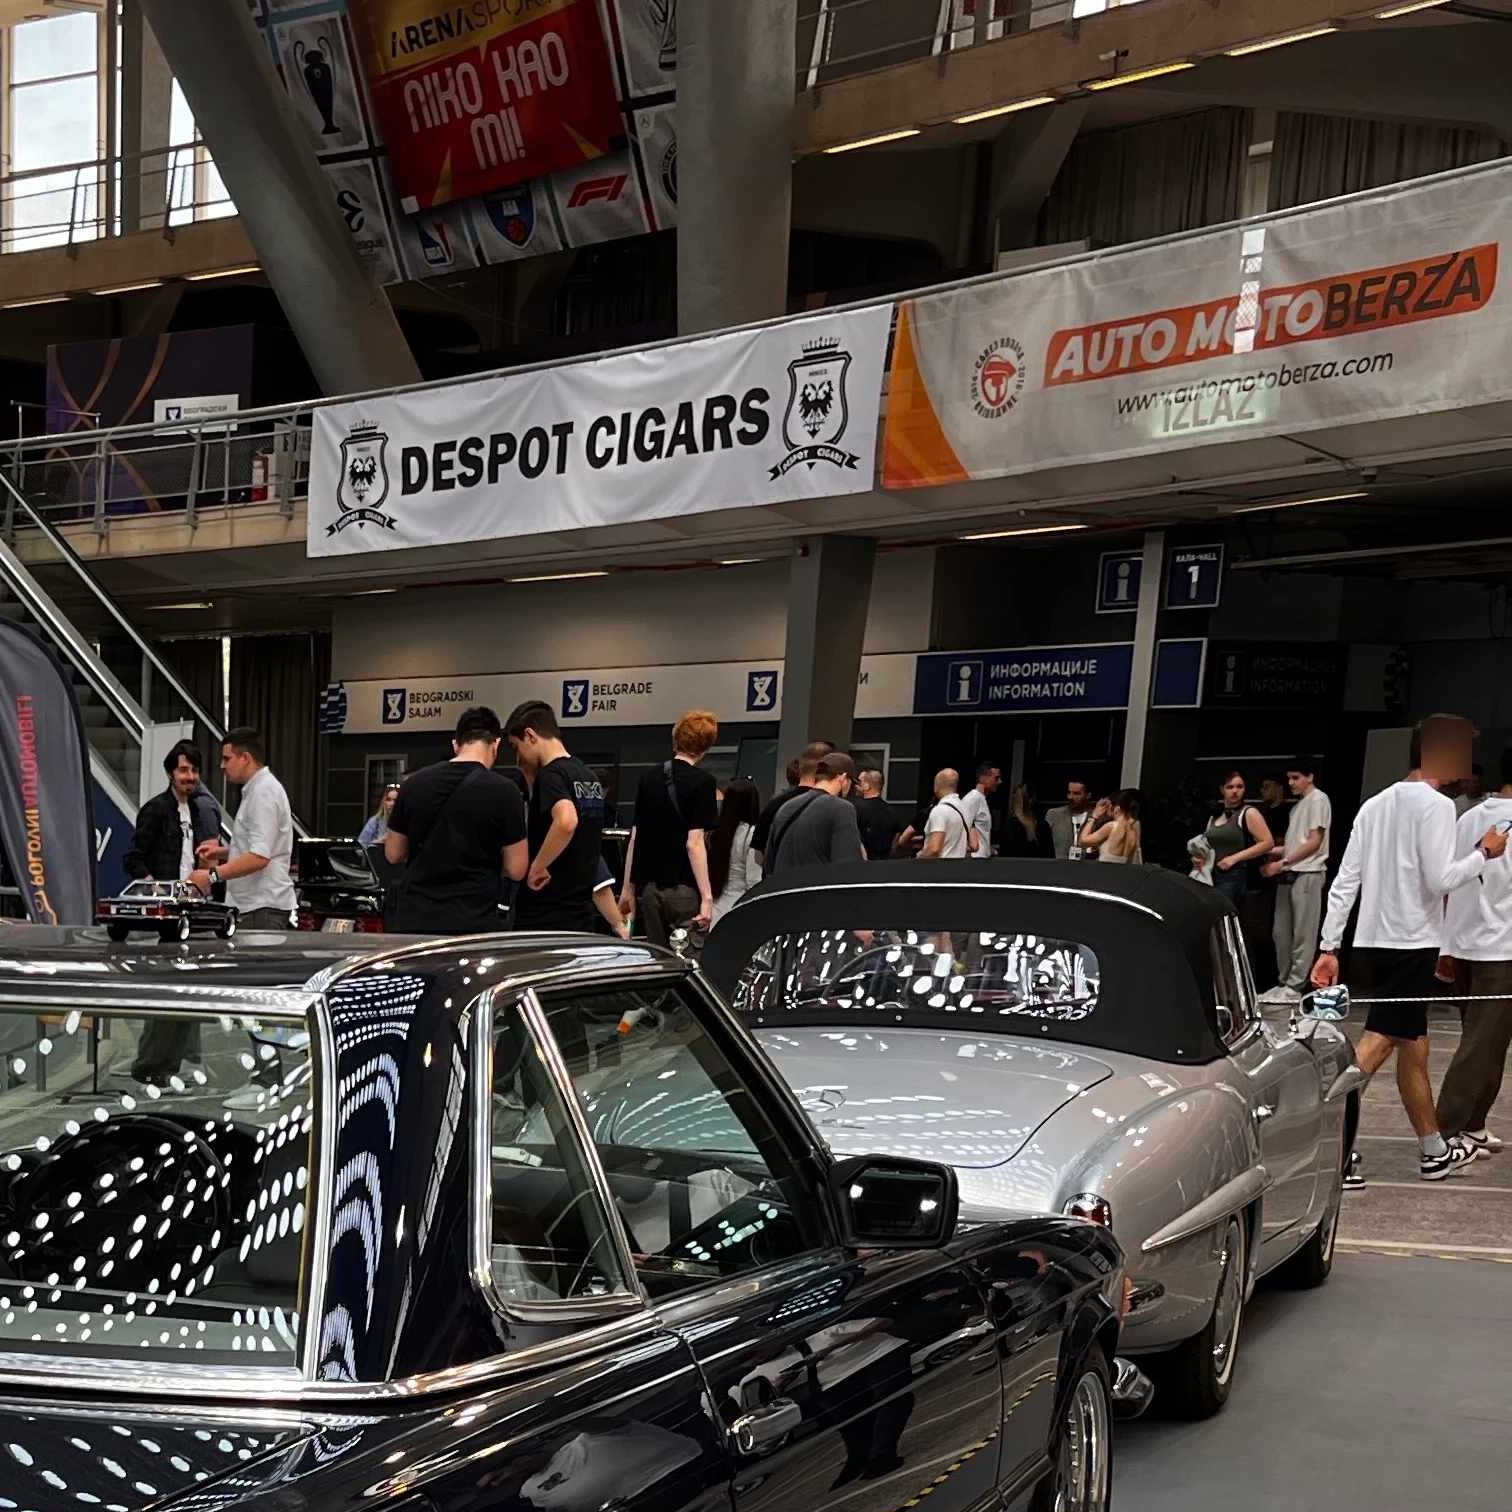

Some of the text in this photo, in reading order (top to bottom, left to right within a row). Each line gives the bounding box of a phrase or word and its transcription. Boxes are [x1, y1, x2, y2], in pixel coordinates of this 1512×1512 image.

[404, 32, 569, 133] NIKO KAO
[471, 106, 527, 171] MI!
[1051, 317, 1178, 379] AUTO
[1117, 352, 1394, 415] www.automotoberza.com
[1161, 390, 1256, 434] IZLAZ
[400, 387, 771, 497] DESPOT CIGARS
[1187, 565, 1200, 599] 1
[990, 660, 1098, 679] ИНФОРМАЦИЈЕ
[408, 690, 474, 704] BEOGRADSKI
[591, 700, 617, 712] FAIR
[592, 682, 653, 696] BELGRADE
[988, 681, 1086, 699] INFORMATION
[408, 707, 442, 718] SAJAM
